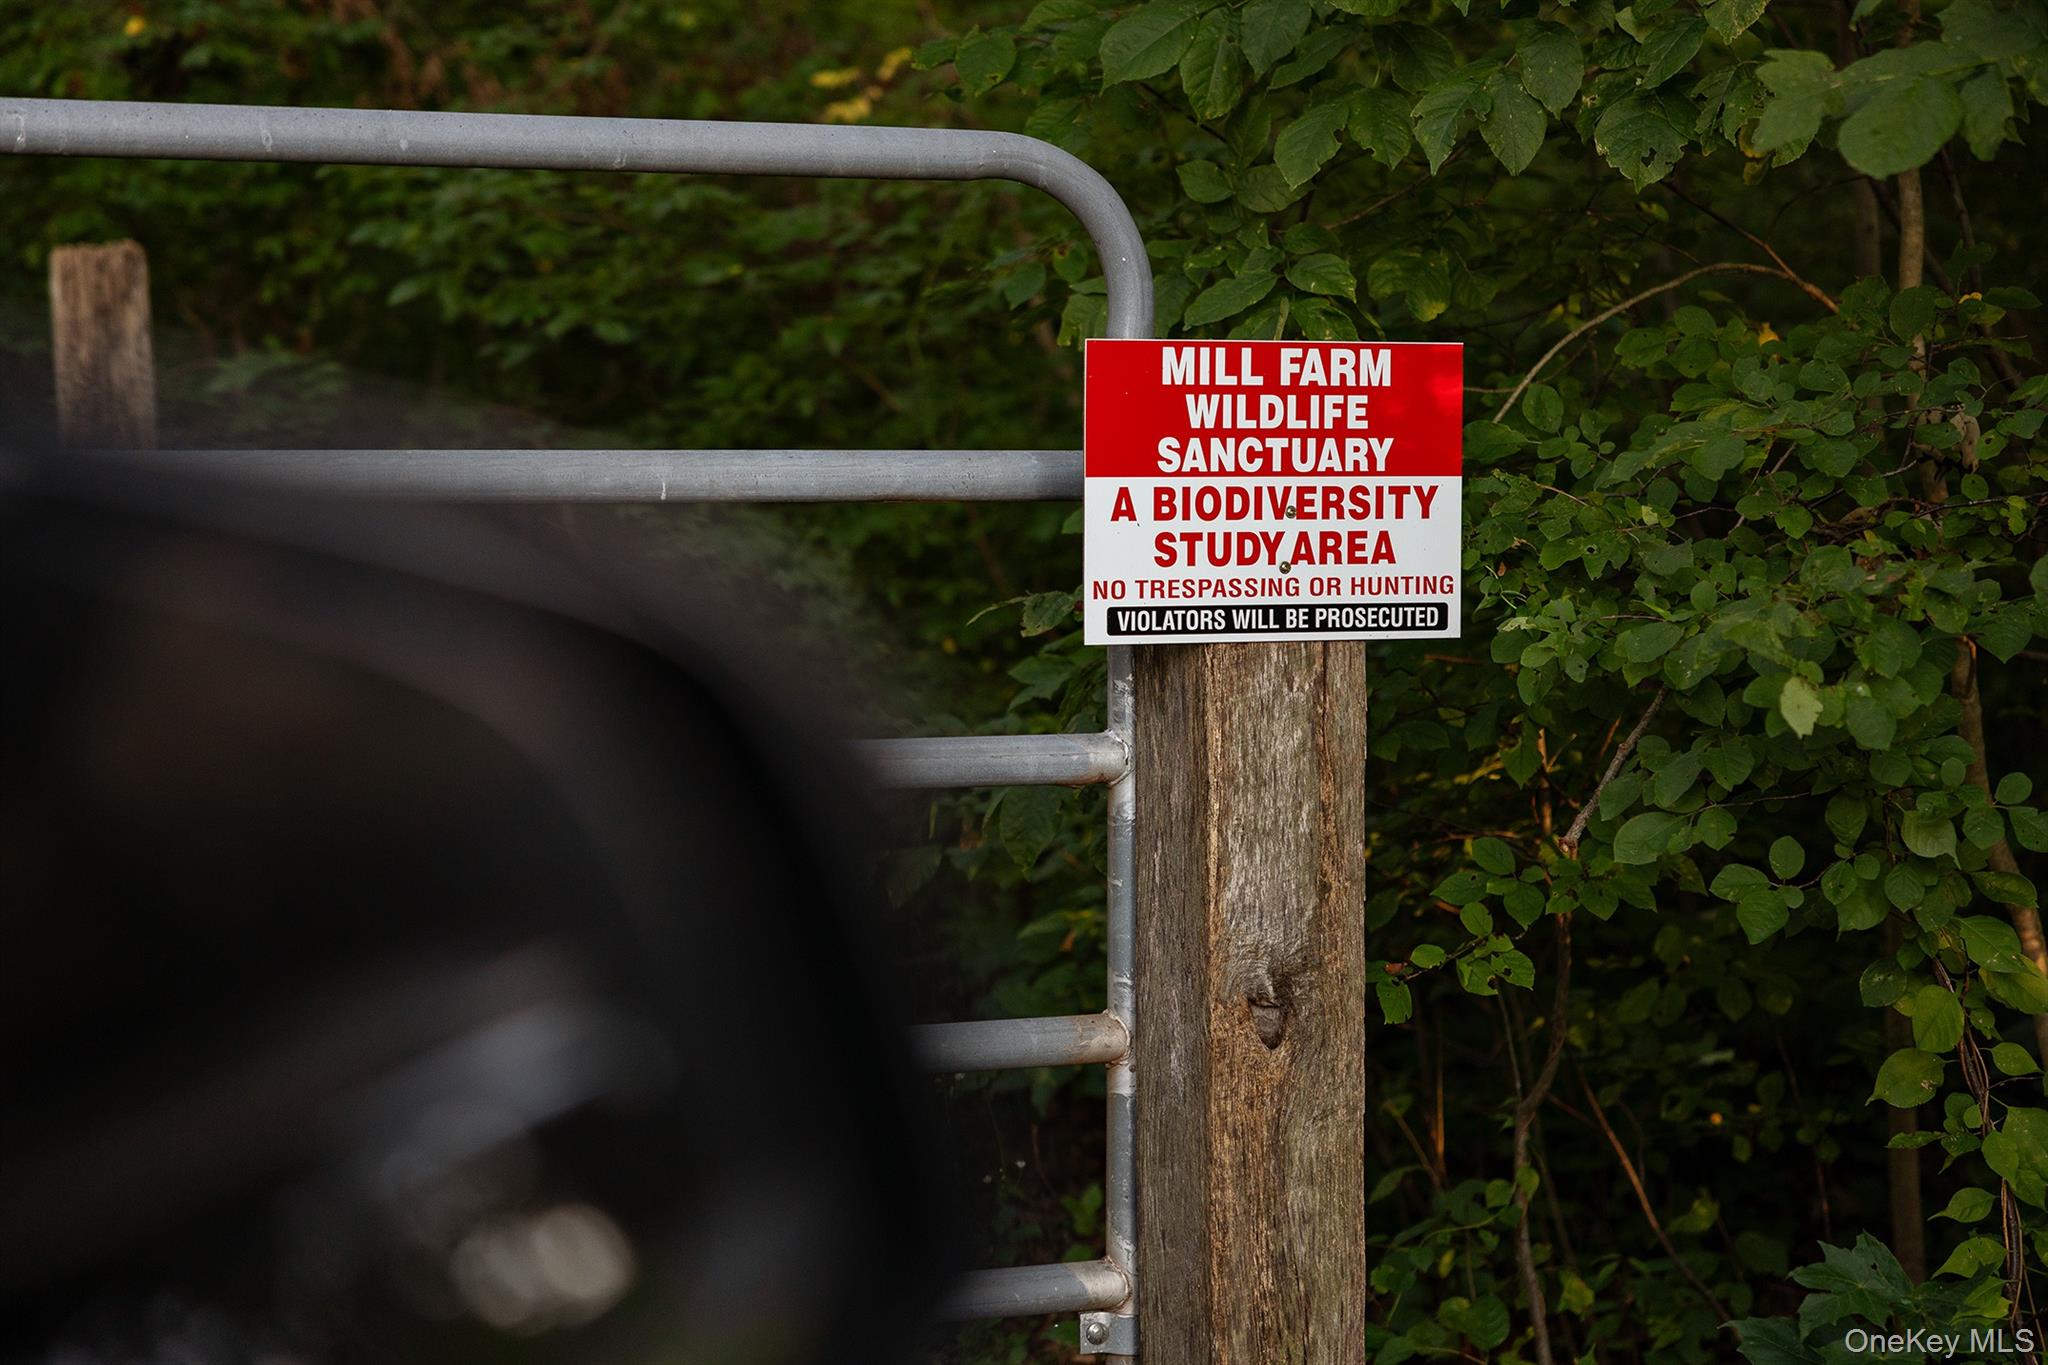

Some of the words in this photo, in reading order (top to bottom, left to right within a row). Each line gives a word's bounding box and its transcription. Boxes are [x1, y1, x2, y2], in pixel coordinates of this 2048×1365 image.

[1162, 347, 1263, 386] MILL
[1280, 348, 1391, 387] FARM
[1186, 395, 1368, 429] WILDLIFE
[1157, 437, 1394, 473] SANCTUARY
[1111, 487, 1137, 522] A
[1154, 485, 1439, 521] BIODIVERSITY
[1154, 531, 1285, 567] STUDY
[1290, 531, 1396, 566] AREA
[1093, 580, 1126, 600] NO
[1135, 578, 1300, 599] TRESPASSING
[1310, 577, 1341, 596] OR
[1351, 576, 1454, 596] HUNTING
[1117, 609, 1226, 631] VIOLATORS
[1231, 608, 1279, 629] WILL
[1286, 608, 1309, 629] BE
[1315, 606, 1438, 628] PROSECUTED
